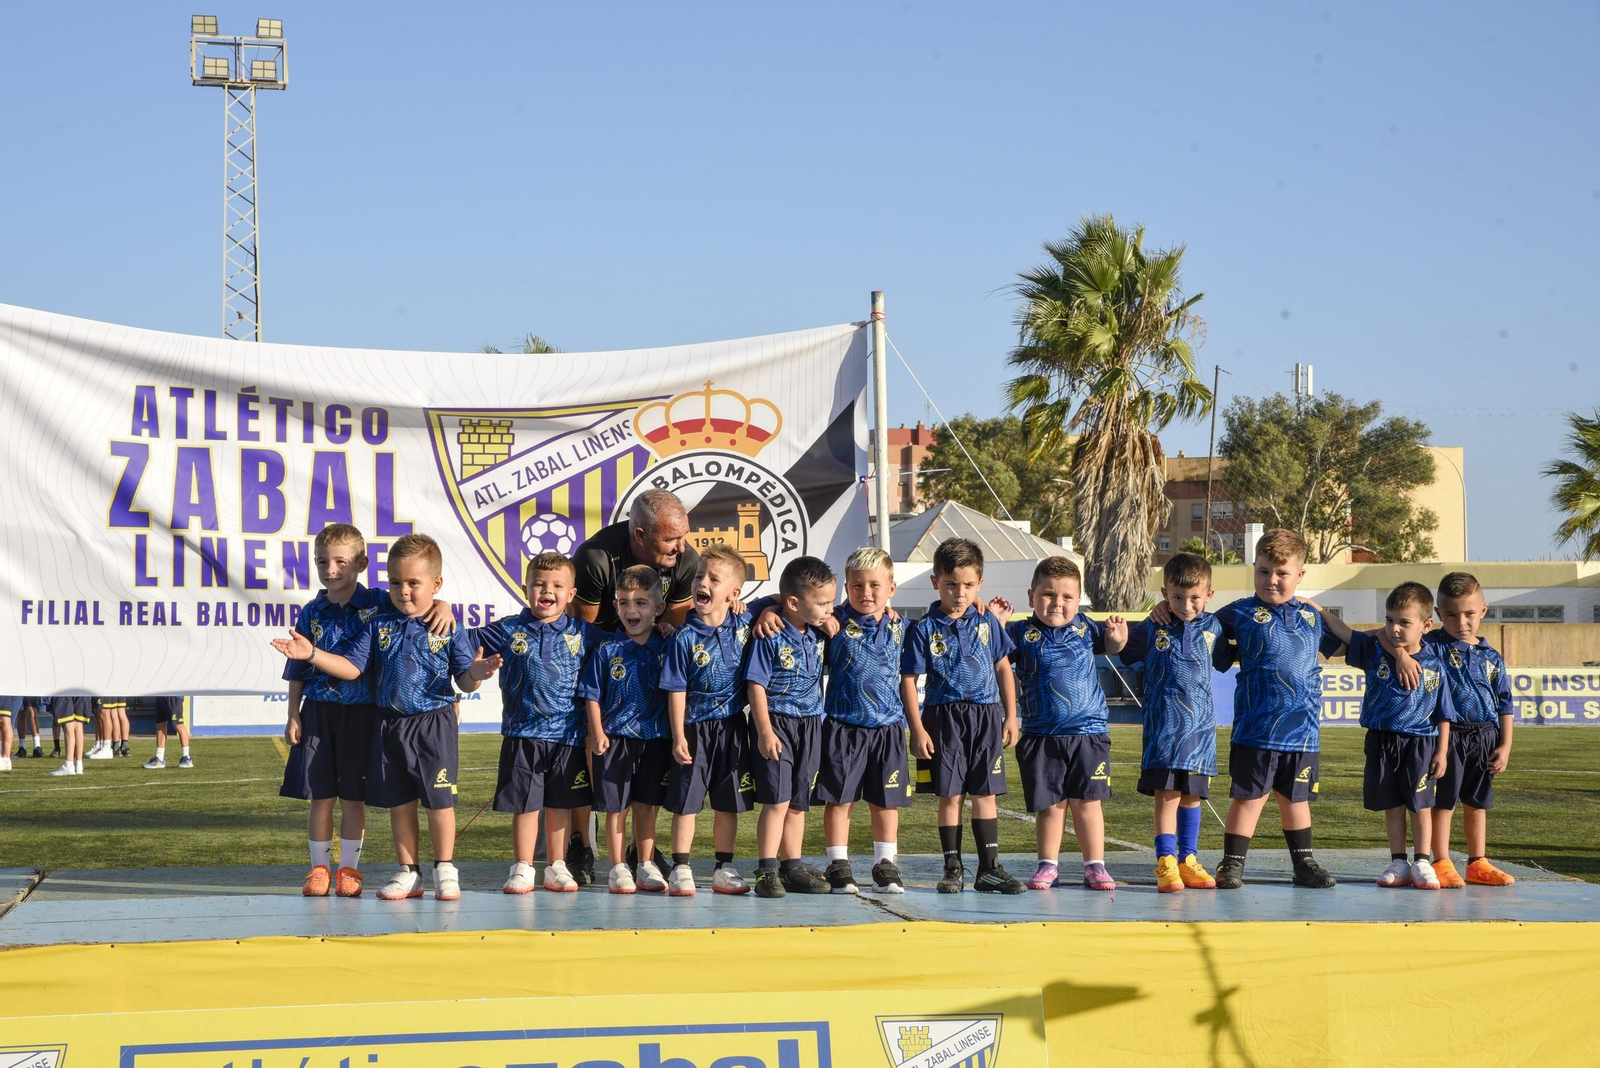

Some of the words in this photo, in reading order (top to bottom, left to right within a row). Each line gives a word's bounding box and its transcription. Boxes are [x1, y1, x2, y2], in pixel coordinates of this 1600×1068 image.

[131, 384, 390, 446] ATLÉTICO
[106, 439, 415, 538] ZABAL
[473, 482, 513, 509] ATL.
[511, 451, 572, 490] ZABAL
[651, 461, 798, 554] BALOMPÉDICA
[134, 533, 389, 590] LINENE
[21, 599, 104, 626] FILIAL
[119, 600, 182, 627] REAL
[924, 1047, 955, 1068] ZABAL
[953, 1025, 991, 1053] LINENSE
